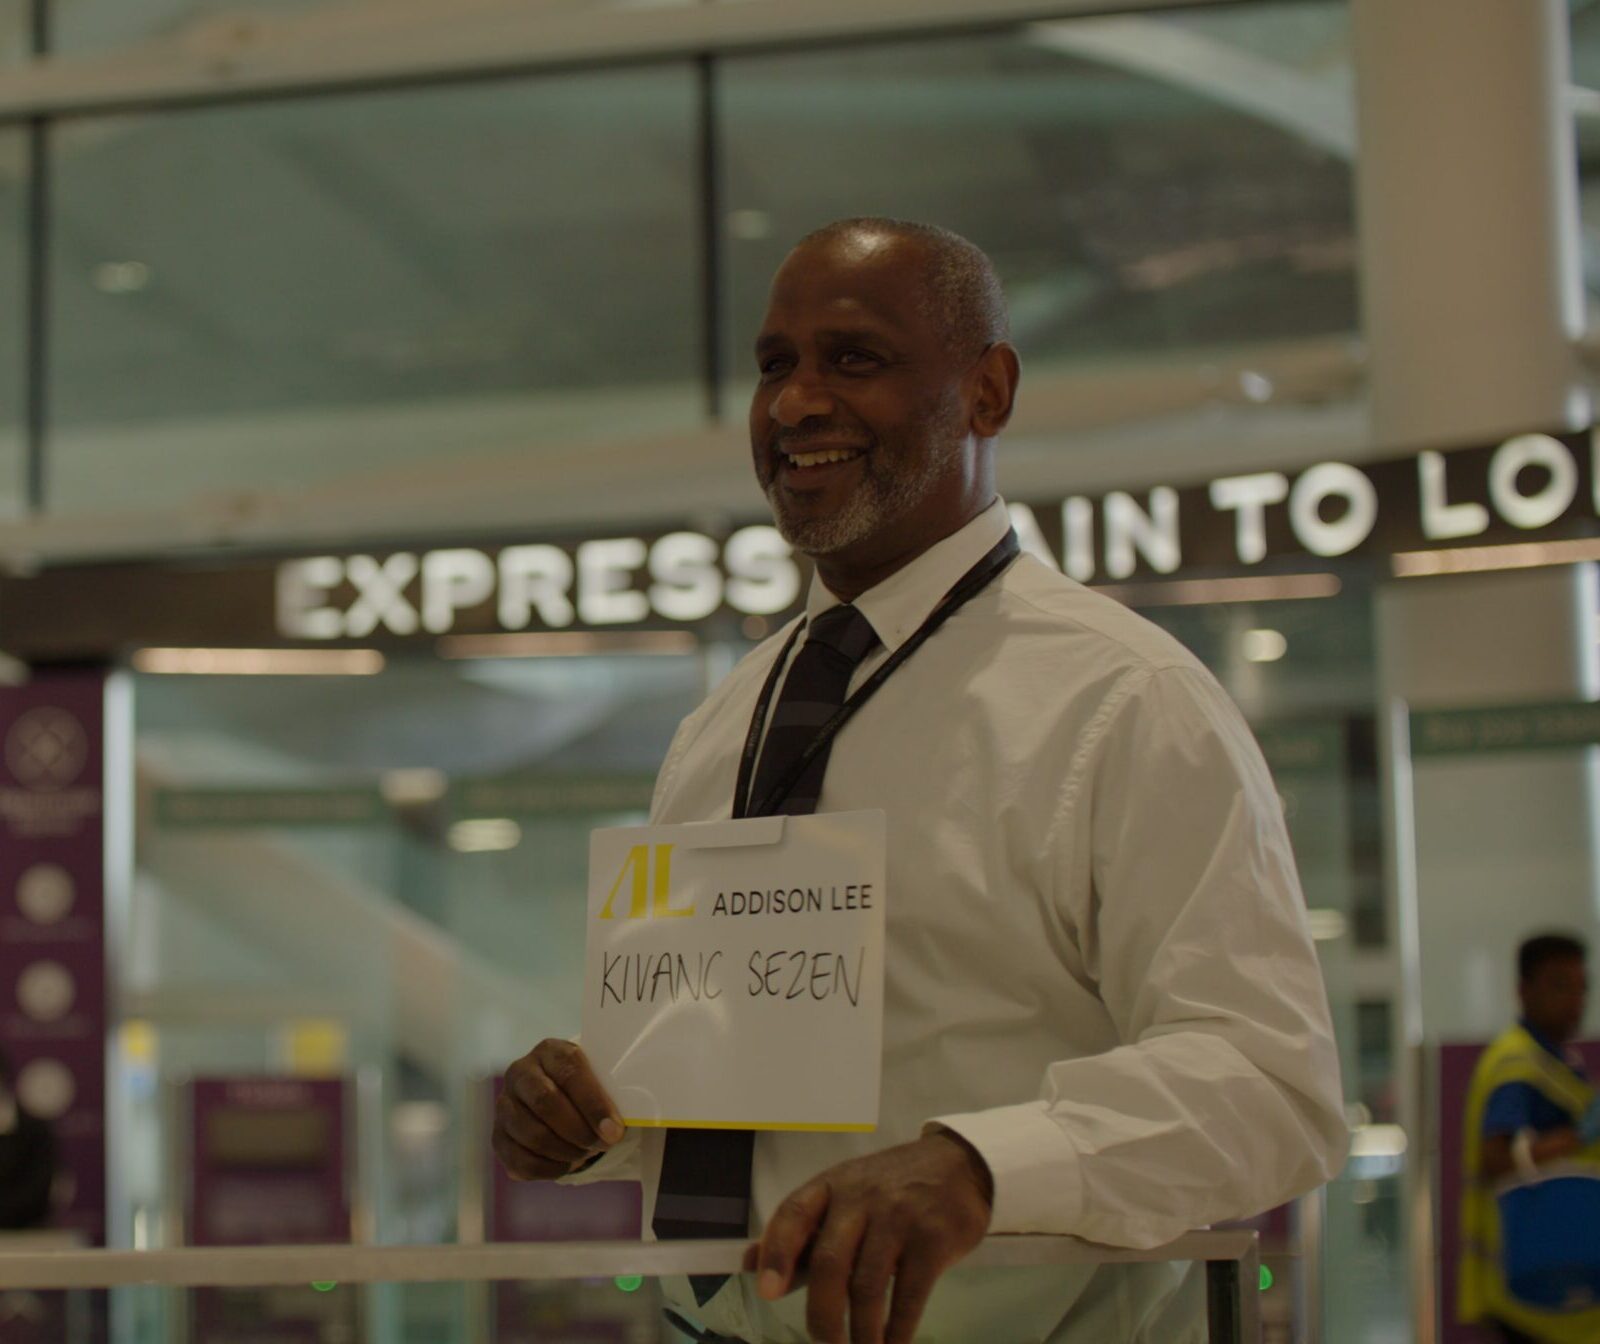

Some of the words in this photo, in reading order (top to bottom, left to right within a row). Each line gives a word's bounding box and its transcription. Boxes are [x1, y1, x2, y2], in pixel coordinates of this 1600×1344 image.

[276, 526, 800, 639] EXPRESS
[1209, 462, 1378, 564] TO
[1418, 433, 1600, 540] LO
[712, 887, 822, 916] ADDISON
[831, 884, 873, 911] LEE
[600, 951, 723, 1008] KIVANC
